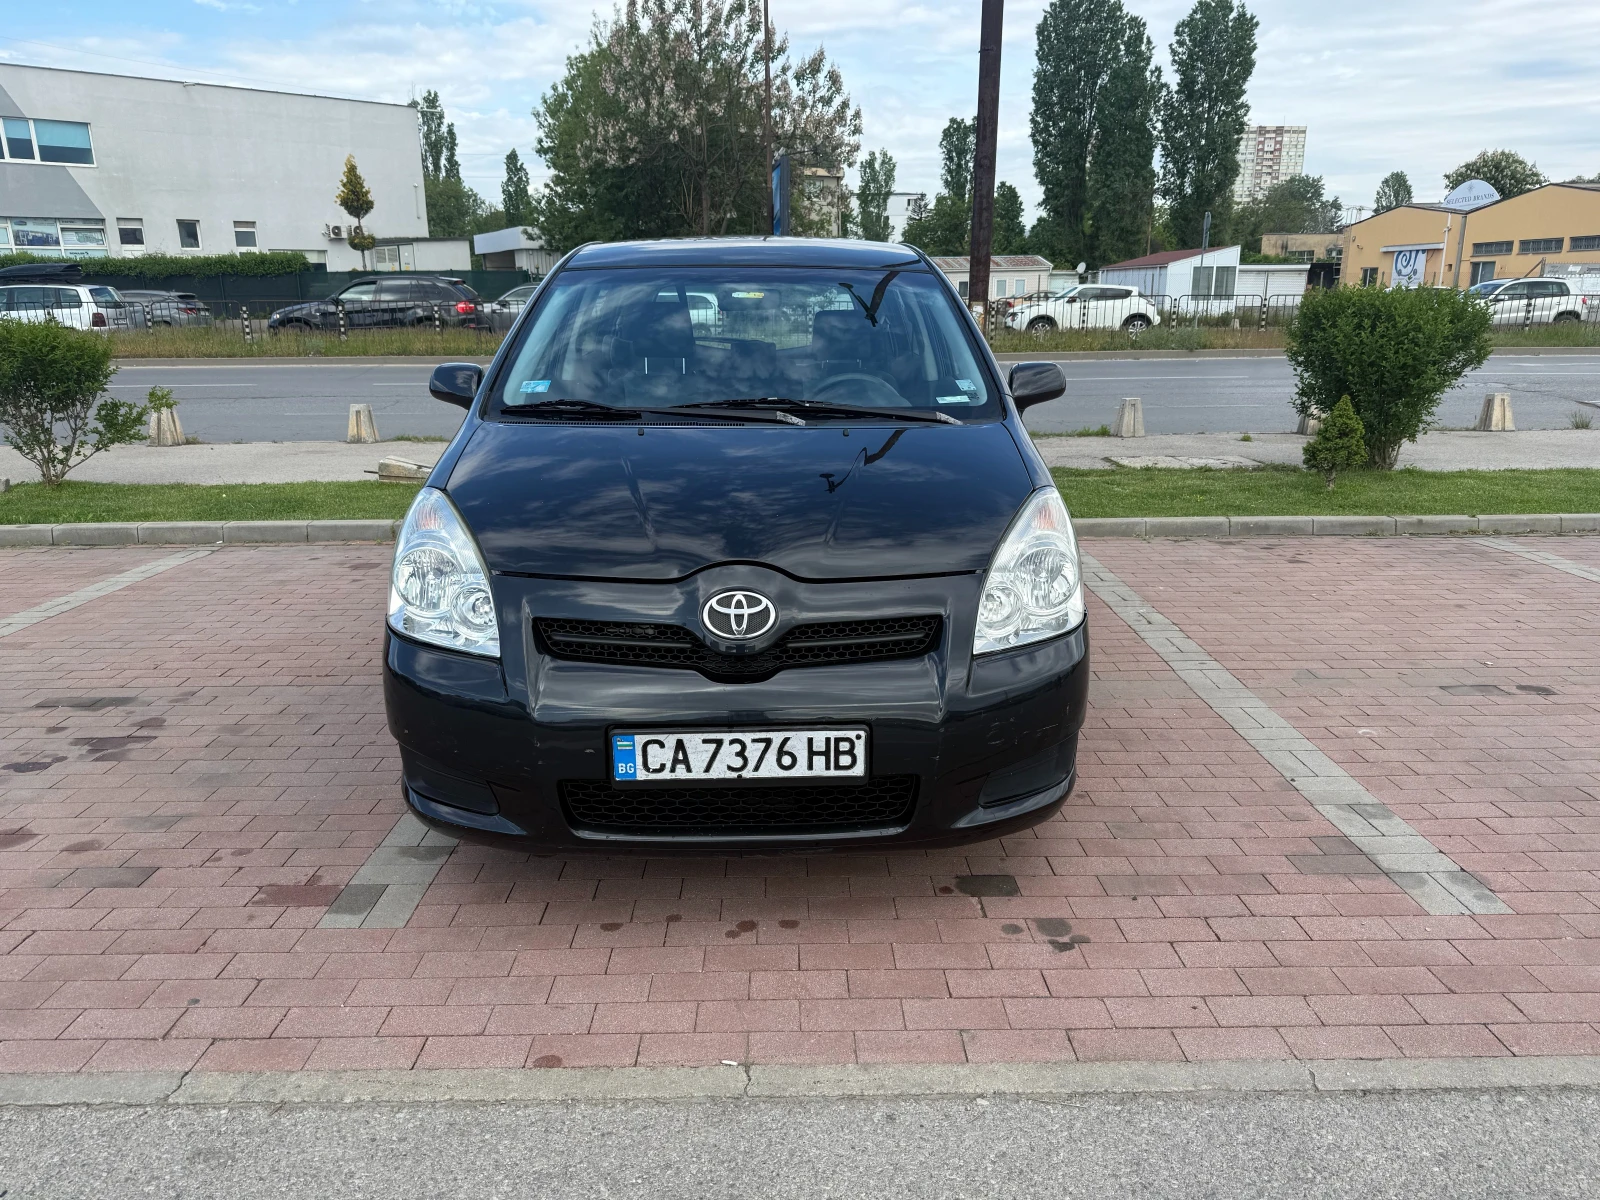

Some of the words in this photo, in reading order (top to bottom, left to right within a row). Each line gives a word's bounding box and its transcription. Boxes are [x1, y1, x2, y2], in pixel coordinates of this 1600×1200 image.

[1446, 196, 1472, 205] SELECTED
[1473, 192, 1495, 202] BRANDS
[641, 738, 692, 773] CA
[701, 737, 798, 773] 7376
[806, 736, 857, 771] HB
[618, 763, 635, 774] BG
